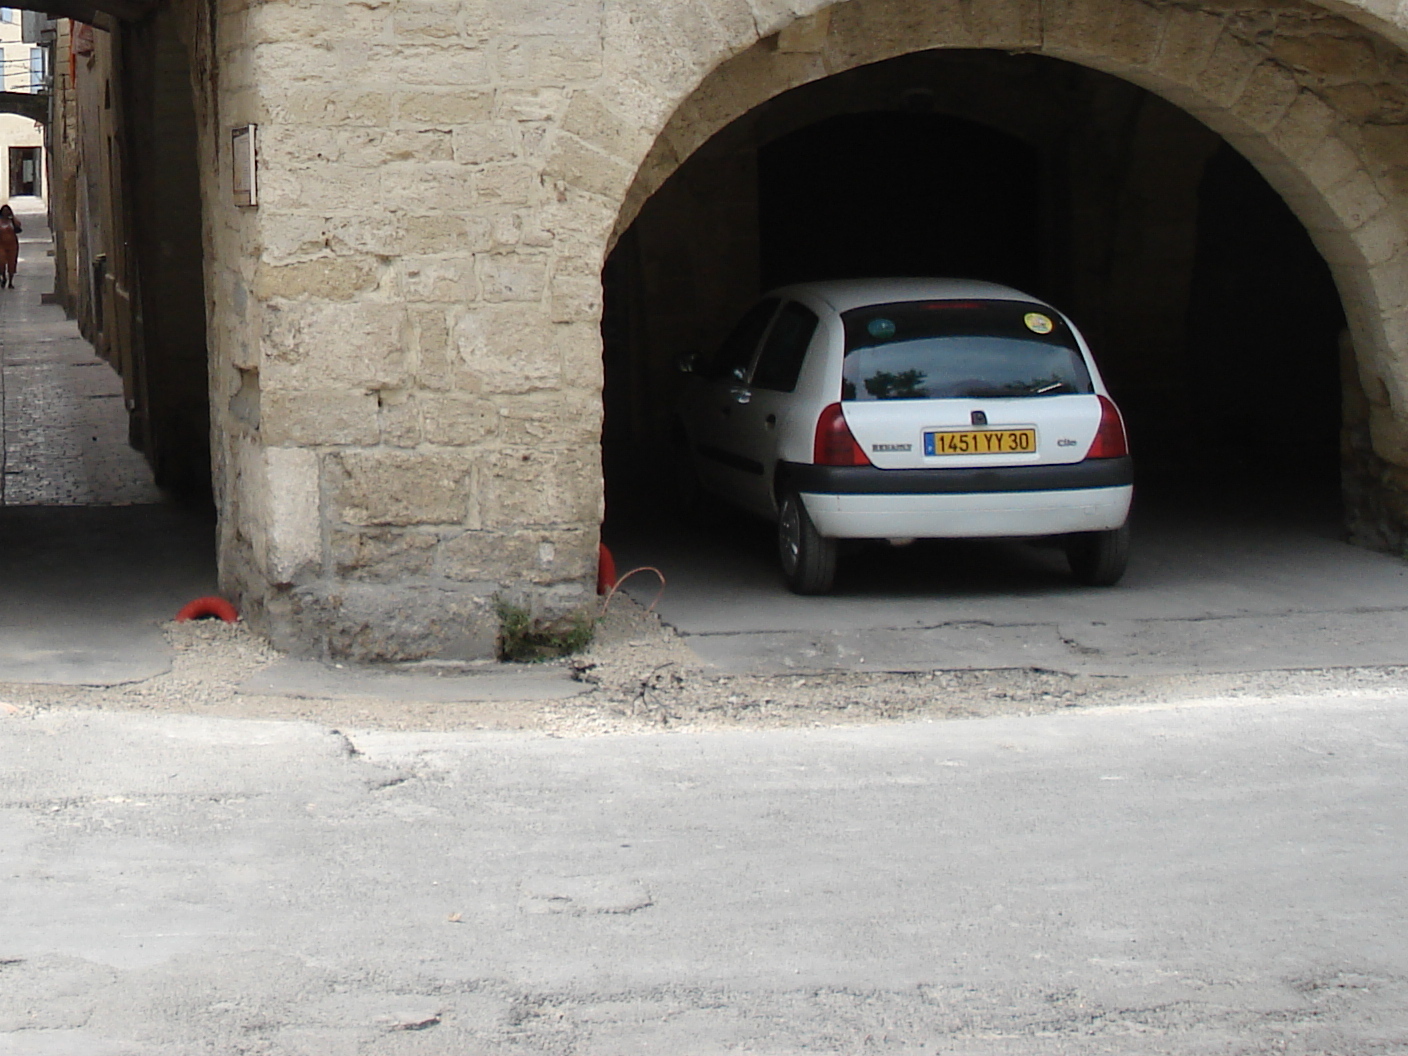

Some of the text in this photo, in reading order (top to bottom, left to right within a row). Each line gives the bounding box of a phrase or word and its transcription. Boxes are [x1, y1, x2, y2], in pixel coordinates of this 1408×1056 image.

[939, 433, 978, 453] 1451
[983, 433, 1004, 452] YY
[1008, 432, 1029, 451] 30
